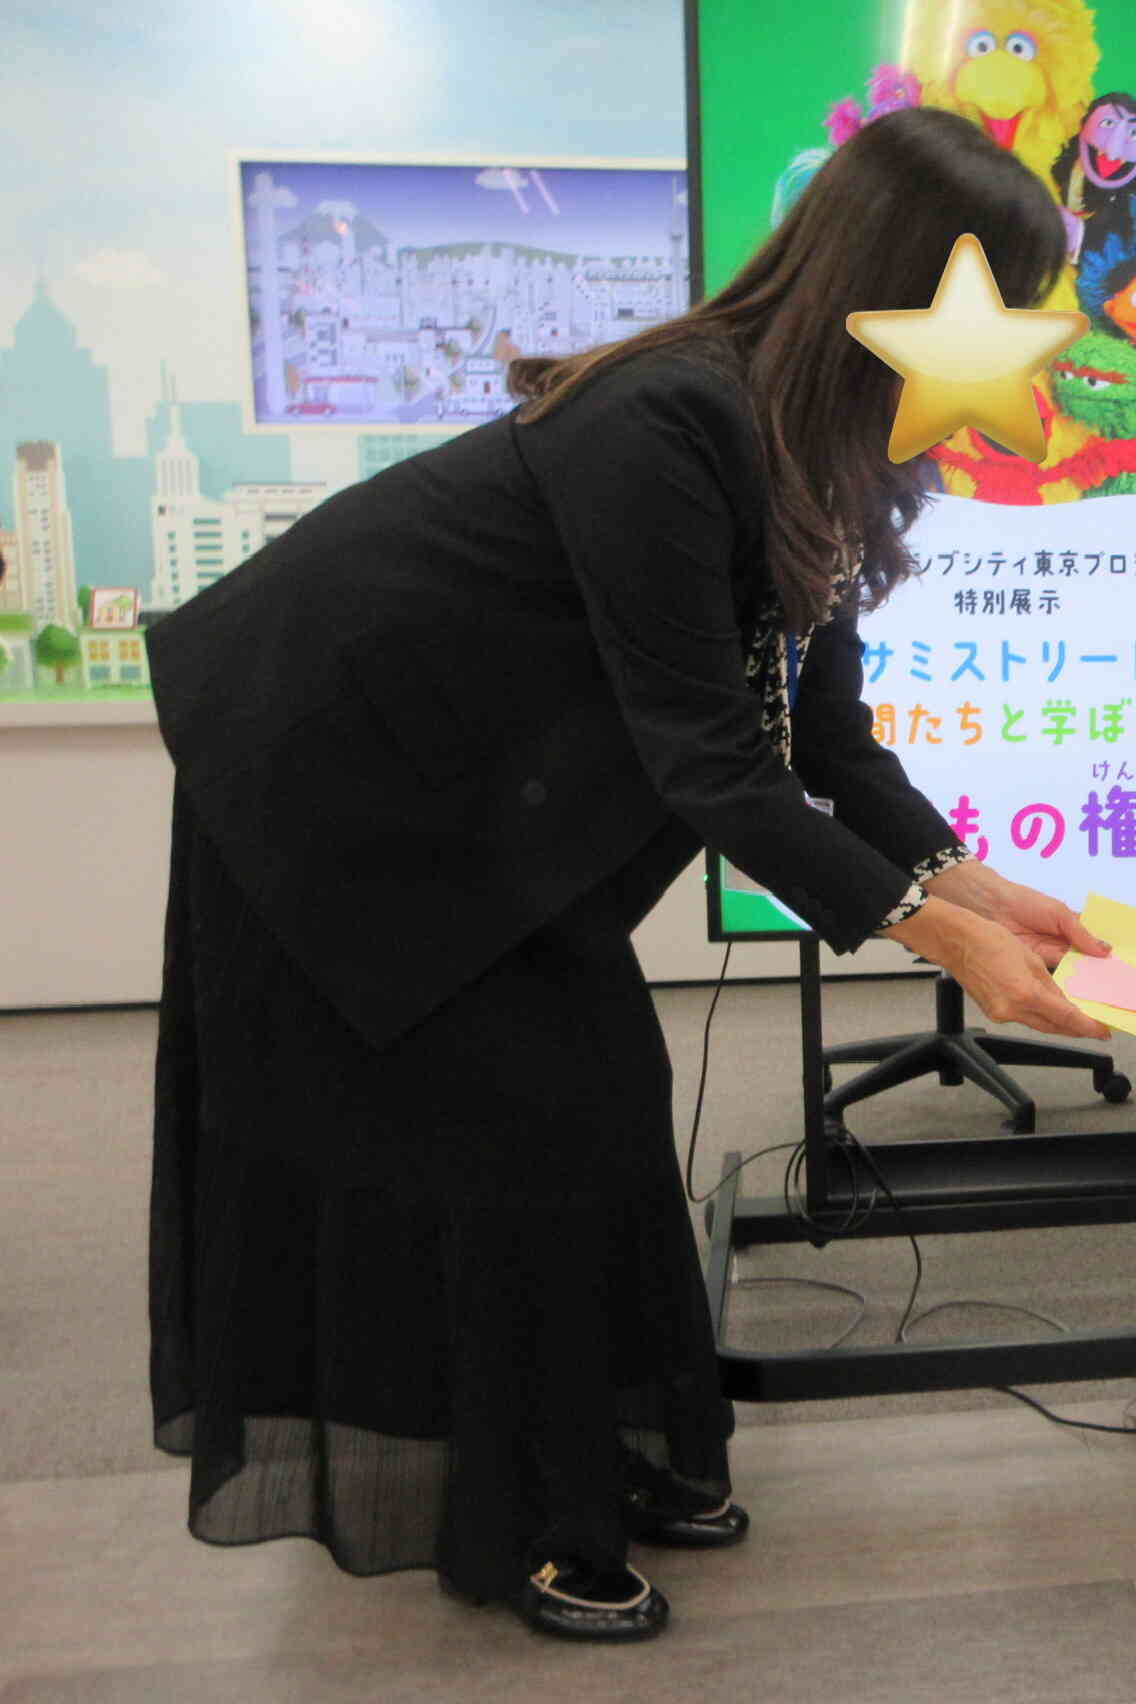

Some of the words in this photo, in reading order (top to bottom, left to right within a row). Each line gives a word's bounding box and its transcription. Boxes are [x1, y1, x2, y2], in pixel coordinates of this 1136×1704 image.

[953, 588, 1061, 616] 特別展示
[1091, 760, 1135, 782] けん
